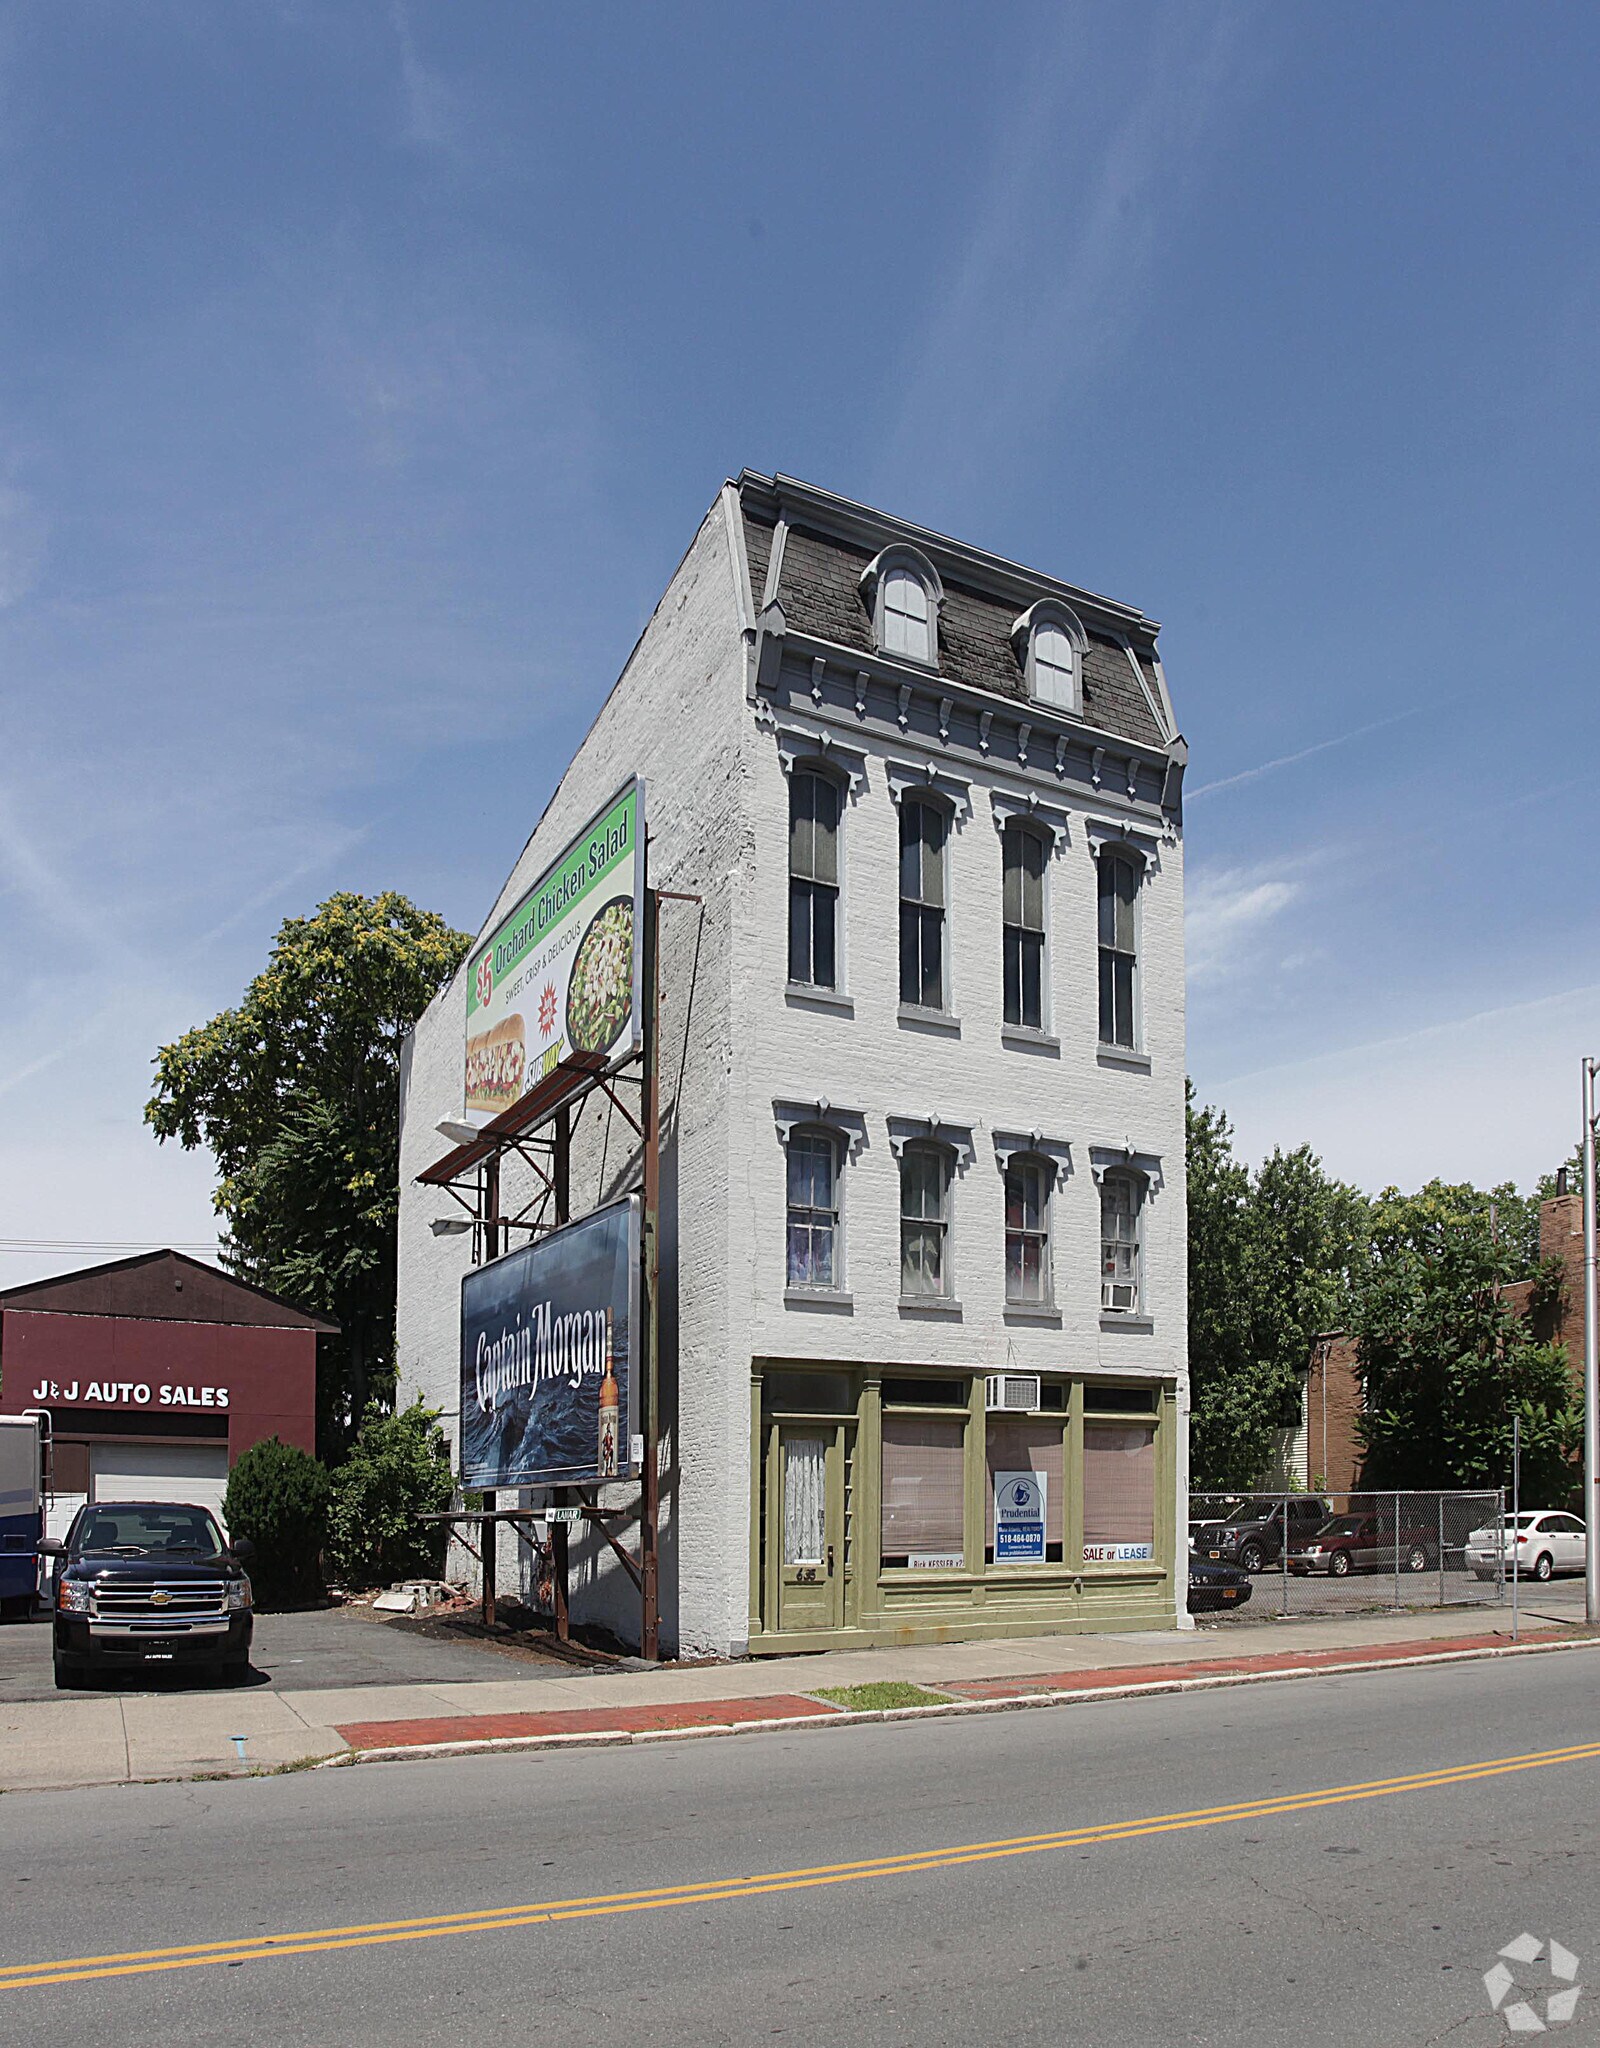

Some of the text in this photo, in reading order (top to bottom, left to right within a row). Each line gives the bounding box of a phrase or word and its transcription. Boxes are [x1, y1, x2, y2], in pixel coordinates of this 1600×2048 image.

[476, 809, 628, 1007] $5 Orchard Chicken Salad
[525, 959, 541, 985] CRISP
[542, 954, 547, 969] &
[548, 920, 582, 964] DELICIOUS
[525, 1032, 565, 1093] SUBWAY
[476, 1301, 606, 1412] Captain Morgan
[84, 1382, 150, 1404] AUTO
[159, 1385, 229, 1408] SALES
[1001, 1507, 1040, 1518] Prudential
[1000, 1534, 1041, 1543] 518-464-0870
[1083, 1547, 1148, 1560] SALE or LEASE
[797, 1568, 816, 1581] 635
